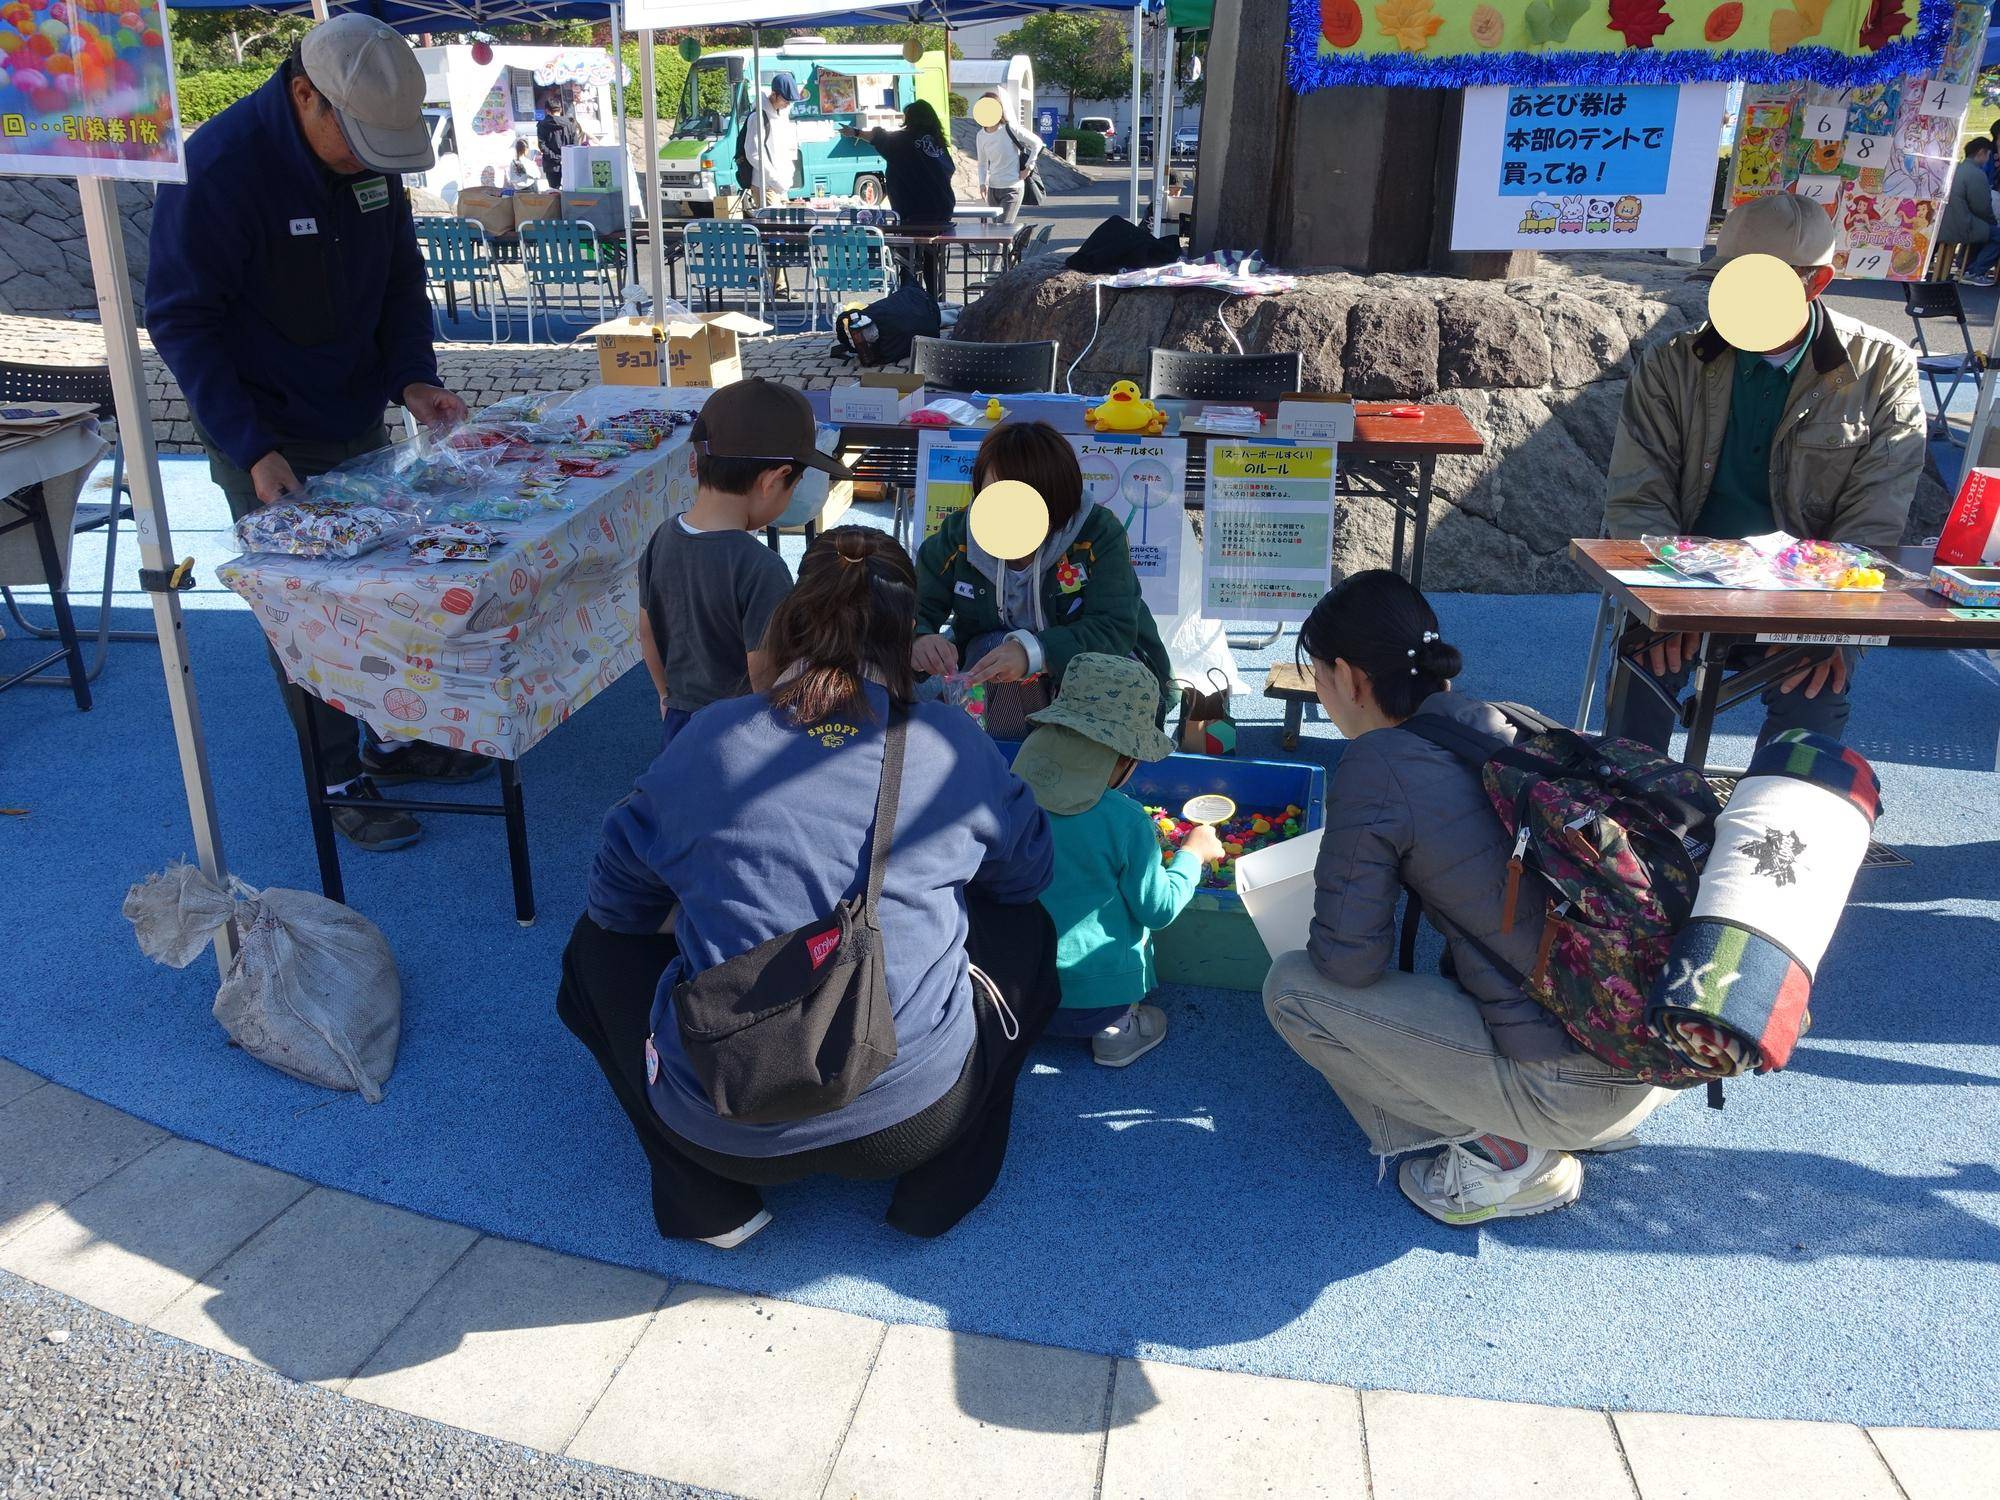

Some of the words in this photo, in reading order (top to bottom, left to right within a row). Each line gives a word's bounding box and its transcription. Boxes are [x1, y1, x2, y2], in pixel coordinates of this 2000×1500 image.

[1509, 92, 1627, 118] あそび券は
[1932, 87, 1950, 110] 4
[1817, 108, 1832, 133] 6
[1506, 126, 1665, 153] 本部のテントで
[1856, 137, 1875, 159] 8
[1804, 185, 1823, 198] 12
[1855, 255, 1881, 270] 19
[616, 349, 692, 368] チョコット
[940, 454, 976, 464] 「スーパー
[1081, 445, 1163, 456] スーパーボールすくい
[1244, 463, 1289, 475] のルール
[1133, 474, 1162, 482] やぶれた
[1960, 472, 1980, 524] RBOUR
[1967, 475, 1987, 527] OHAMA
[807, 723, 859, 737] SNOOPY
[1462, 1181, 1482, 1190] ACOSTE
